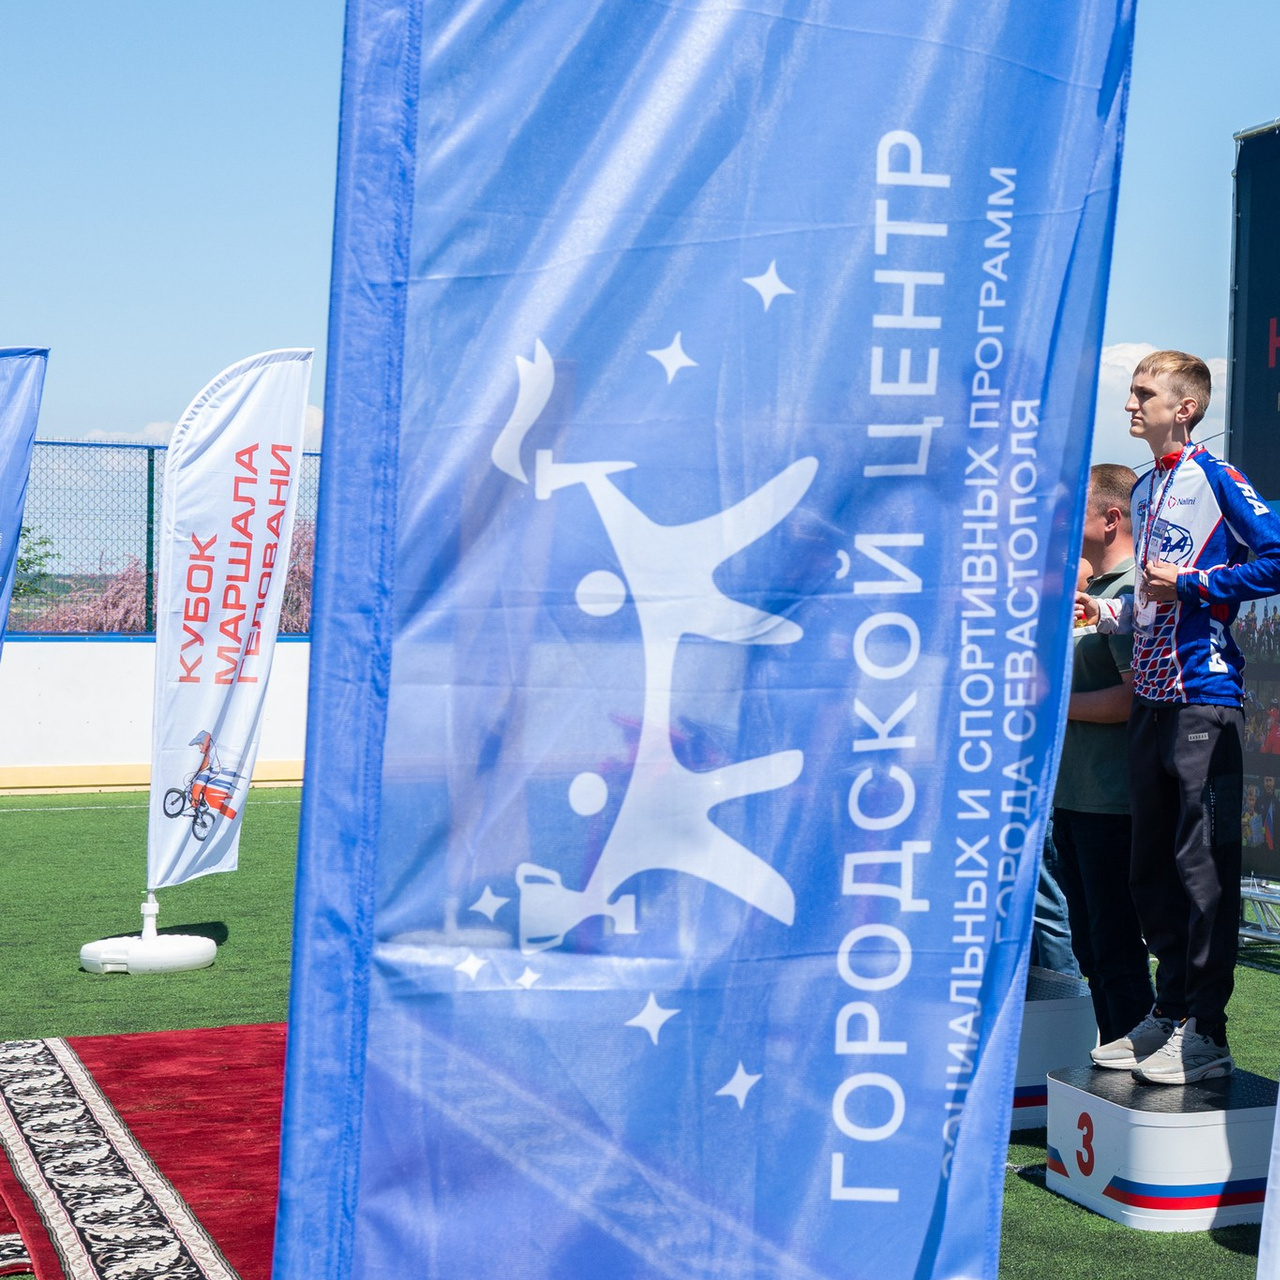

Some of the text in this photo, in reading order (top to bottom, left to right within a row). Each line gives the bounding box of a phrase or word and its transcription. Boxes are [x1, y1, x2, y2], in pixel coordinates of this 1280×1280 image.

[969, 166, 1017, 429] ПРОГРАММ
[179, 532, 218, 684] КУБОК
[214, 443, 259, 685] МАРШАЛА
[830, 129, 951, 1203] ГОРОДСКОЙ ЦЕНТР
[958, 444, 999, 773] СПОРТИВНЫХ
[1003, 400, 1040, 742] СЕВАСТОПОЛЯ
[957, 789, 991, 820] И
[1076, 1111, 1095, 1177] 3
